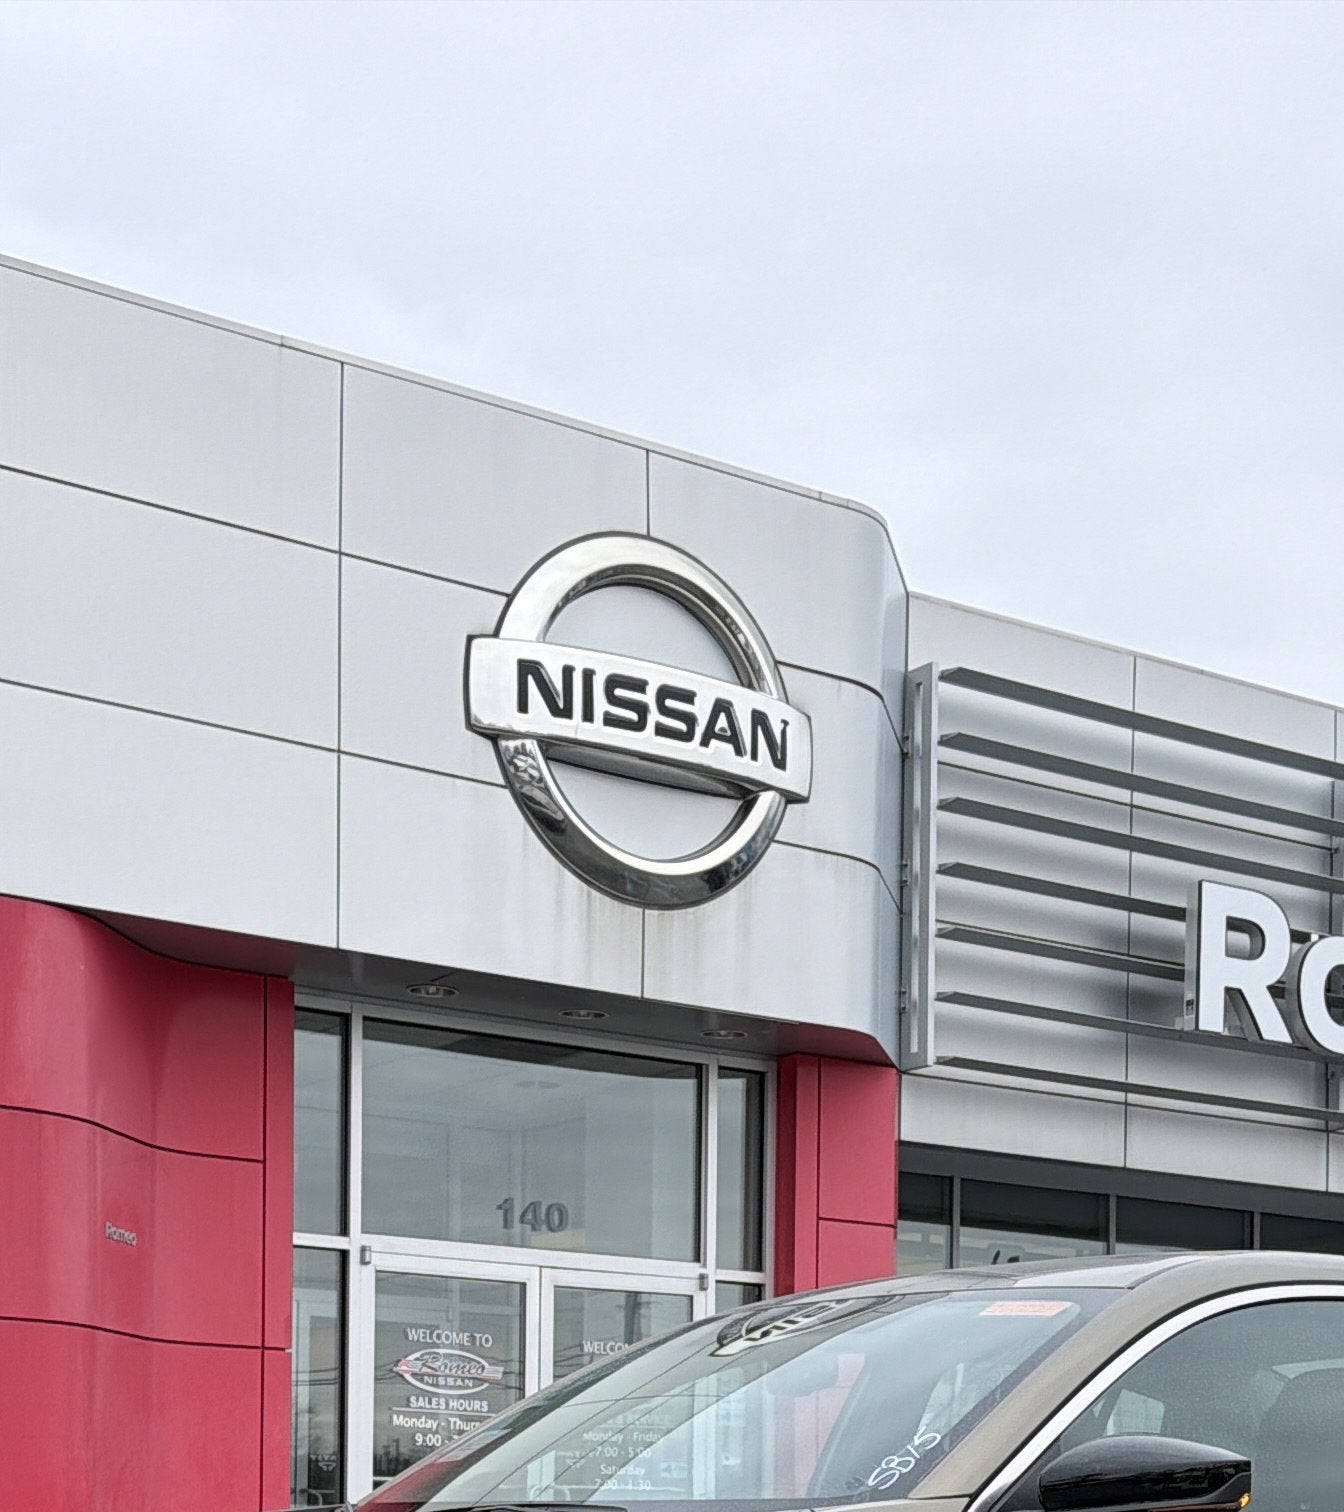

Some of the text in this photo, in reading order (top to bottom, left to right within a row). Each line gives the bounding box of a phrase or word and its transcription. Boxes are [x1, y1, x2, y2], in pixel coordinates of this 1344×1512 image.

[516, 657, 790, 772] NISSAN
[496, 1197, 569, 1233] 140
[105, 1220, 136, 1247] Romeo
[407, 1327, 493, 1348] WELCOME TO
[418, 1351, 486, 1375] Romeo
[423, 1376, 474, 1388] NISSAN
[409, 1395, 489, 1413] SALES HOURS
[392, 1414, 439, 1431] Monday
[414, 1432, 442, 1447] 9:00
[582, 1431, 624, 1444] Monday
[600, 1463, 646, 1477] Saturday
